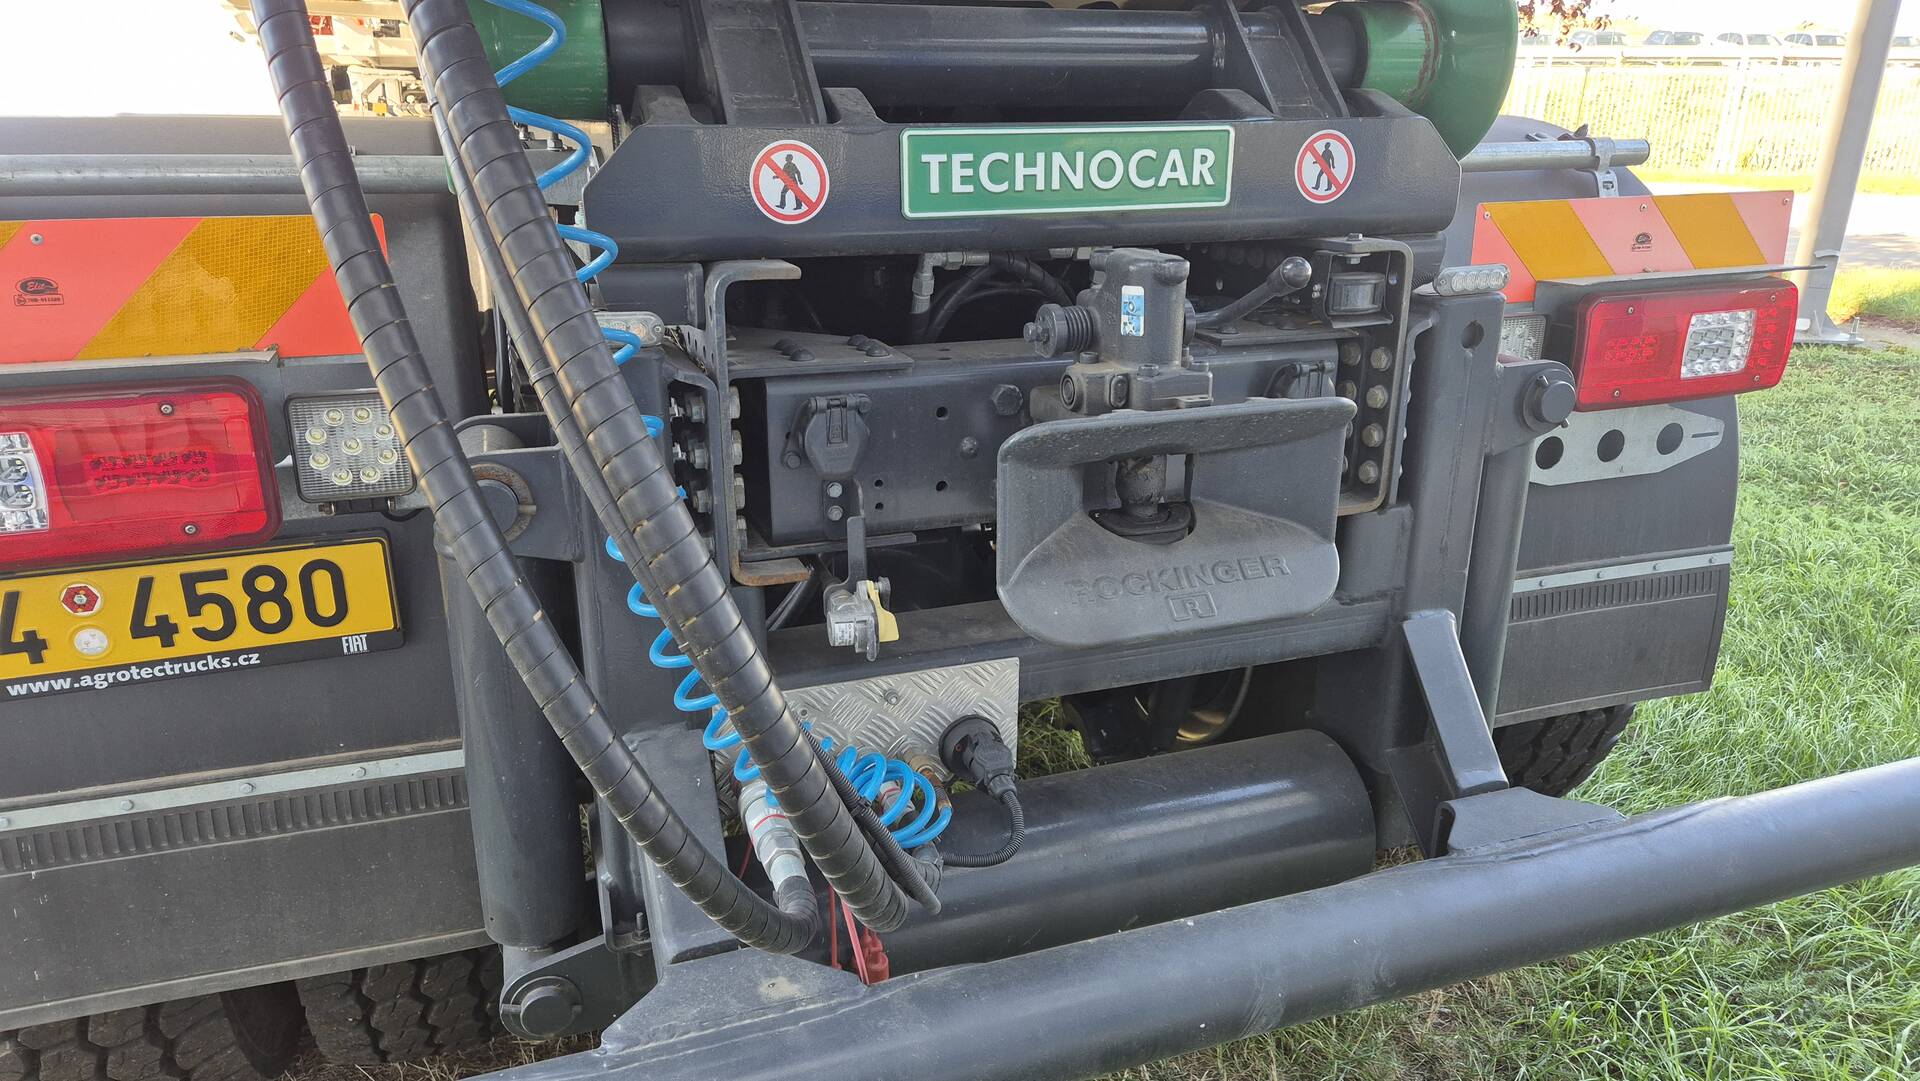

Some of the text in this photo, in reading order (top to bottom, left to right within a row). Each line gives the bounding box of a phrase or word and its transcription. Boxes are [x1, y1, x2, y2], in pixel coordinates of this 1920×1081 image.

[921, 148, 1216, 194] TECHNOCAR
[1065, 554, 1292, 604] ROCKINGER
[0, 558, 349, 664] 4 4580
[341, 634, 368, 654] FIAT
[6, 652, 261, 696] www.agrotectrucks.cz
